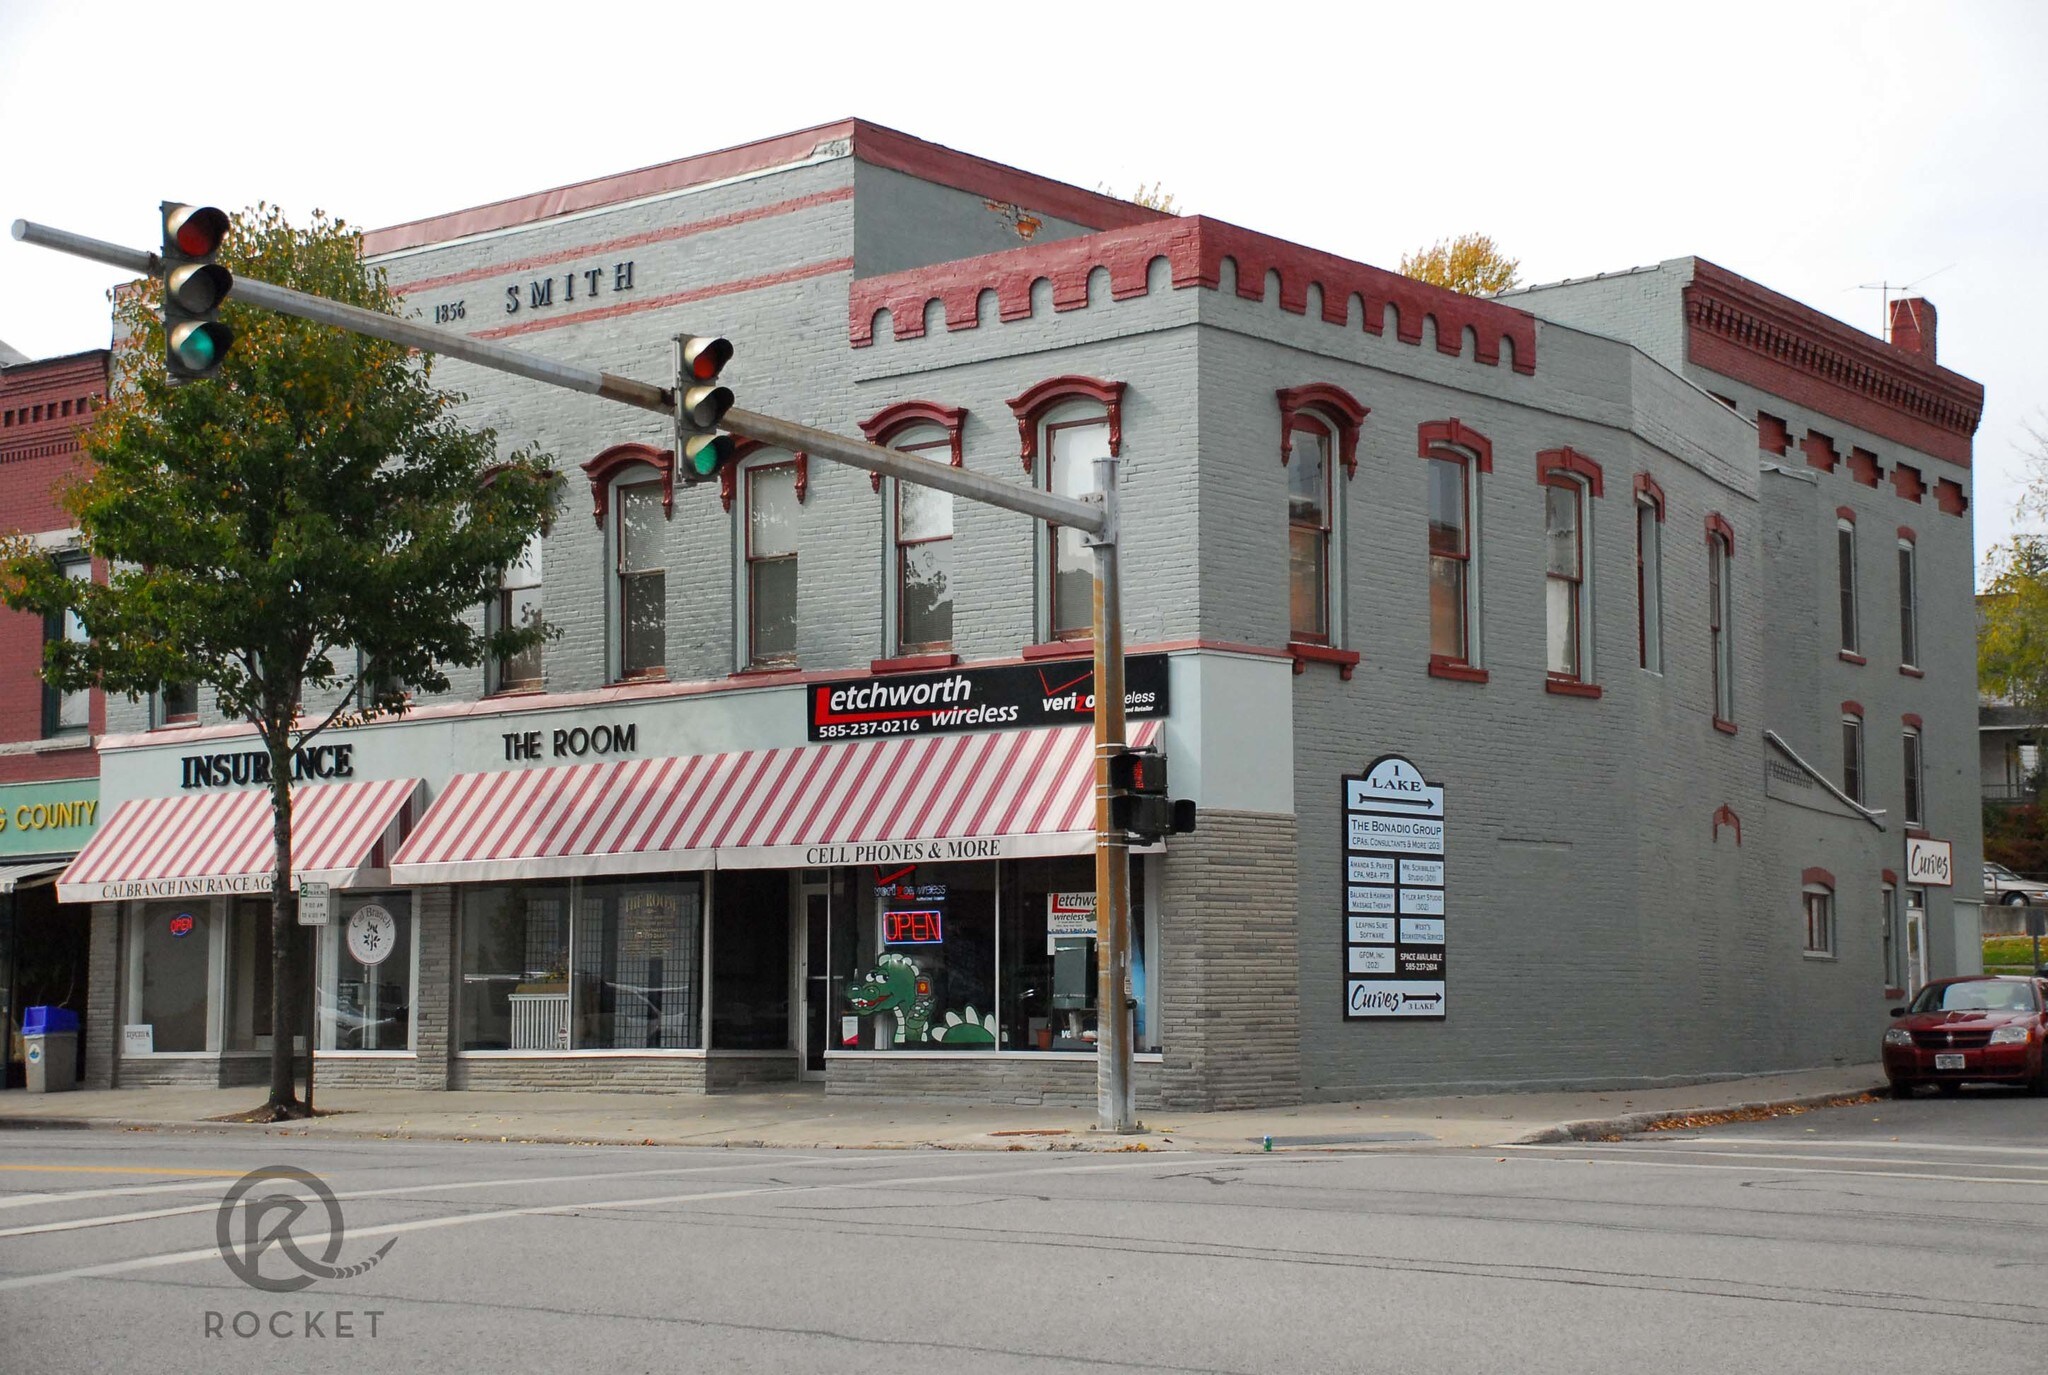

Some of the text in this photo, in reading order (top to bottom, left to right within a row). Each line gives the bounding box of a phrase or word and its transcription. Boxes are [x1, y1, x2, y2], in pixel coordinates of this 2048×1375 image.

[506, 261, 634, 314] SMITH
[435, 300, 466, 324] 1856
[815, 675, 972, 725] Letchworth
[1043, 691, 1155, 711] verizo eless
[931, 705, 1018, 726] wireless
[819, 719, 919, 738] 585-237-0216
[503, 723, 637, 761] THE ROOM
[181, 744, 353, 788] INSURNCE
[1394, 765, 1401, 776] 1
[1372, 777, 1421, 792] LAKE
[15, 800, 98, 831] COUNTY
[1351, 819, 1441, 836] THE BONADIO GROUP
[806, 839, 1000, 864] CELL PHONES & MORE
[1370, 838, 1407, 849] CONSULTANTS
[1412, 841, 1427, 849] MORE
[1911, 845, 1948, 879] Curves
[179, 877, 249, 894] INSURANCE
[300, 885, 307, 895] 2
[874, 883, 915, 899] verizon
[1052, 894, 1096, 913] Letchwo
[170, 917, 193, 932] OPEN
[1054, 913, 1084, 921] wireless
[885, 913, 940, 941] OPEN
[1400, 952, 1442, 962] SPACE AVAILABLE
[1351, 984, 1400, 1012] Curves
